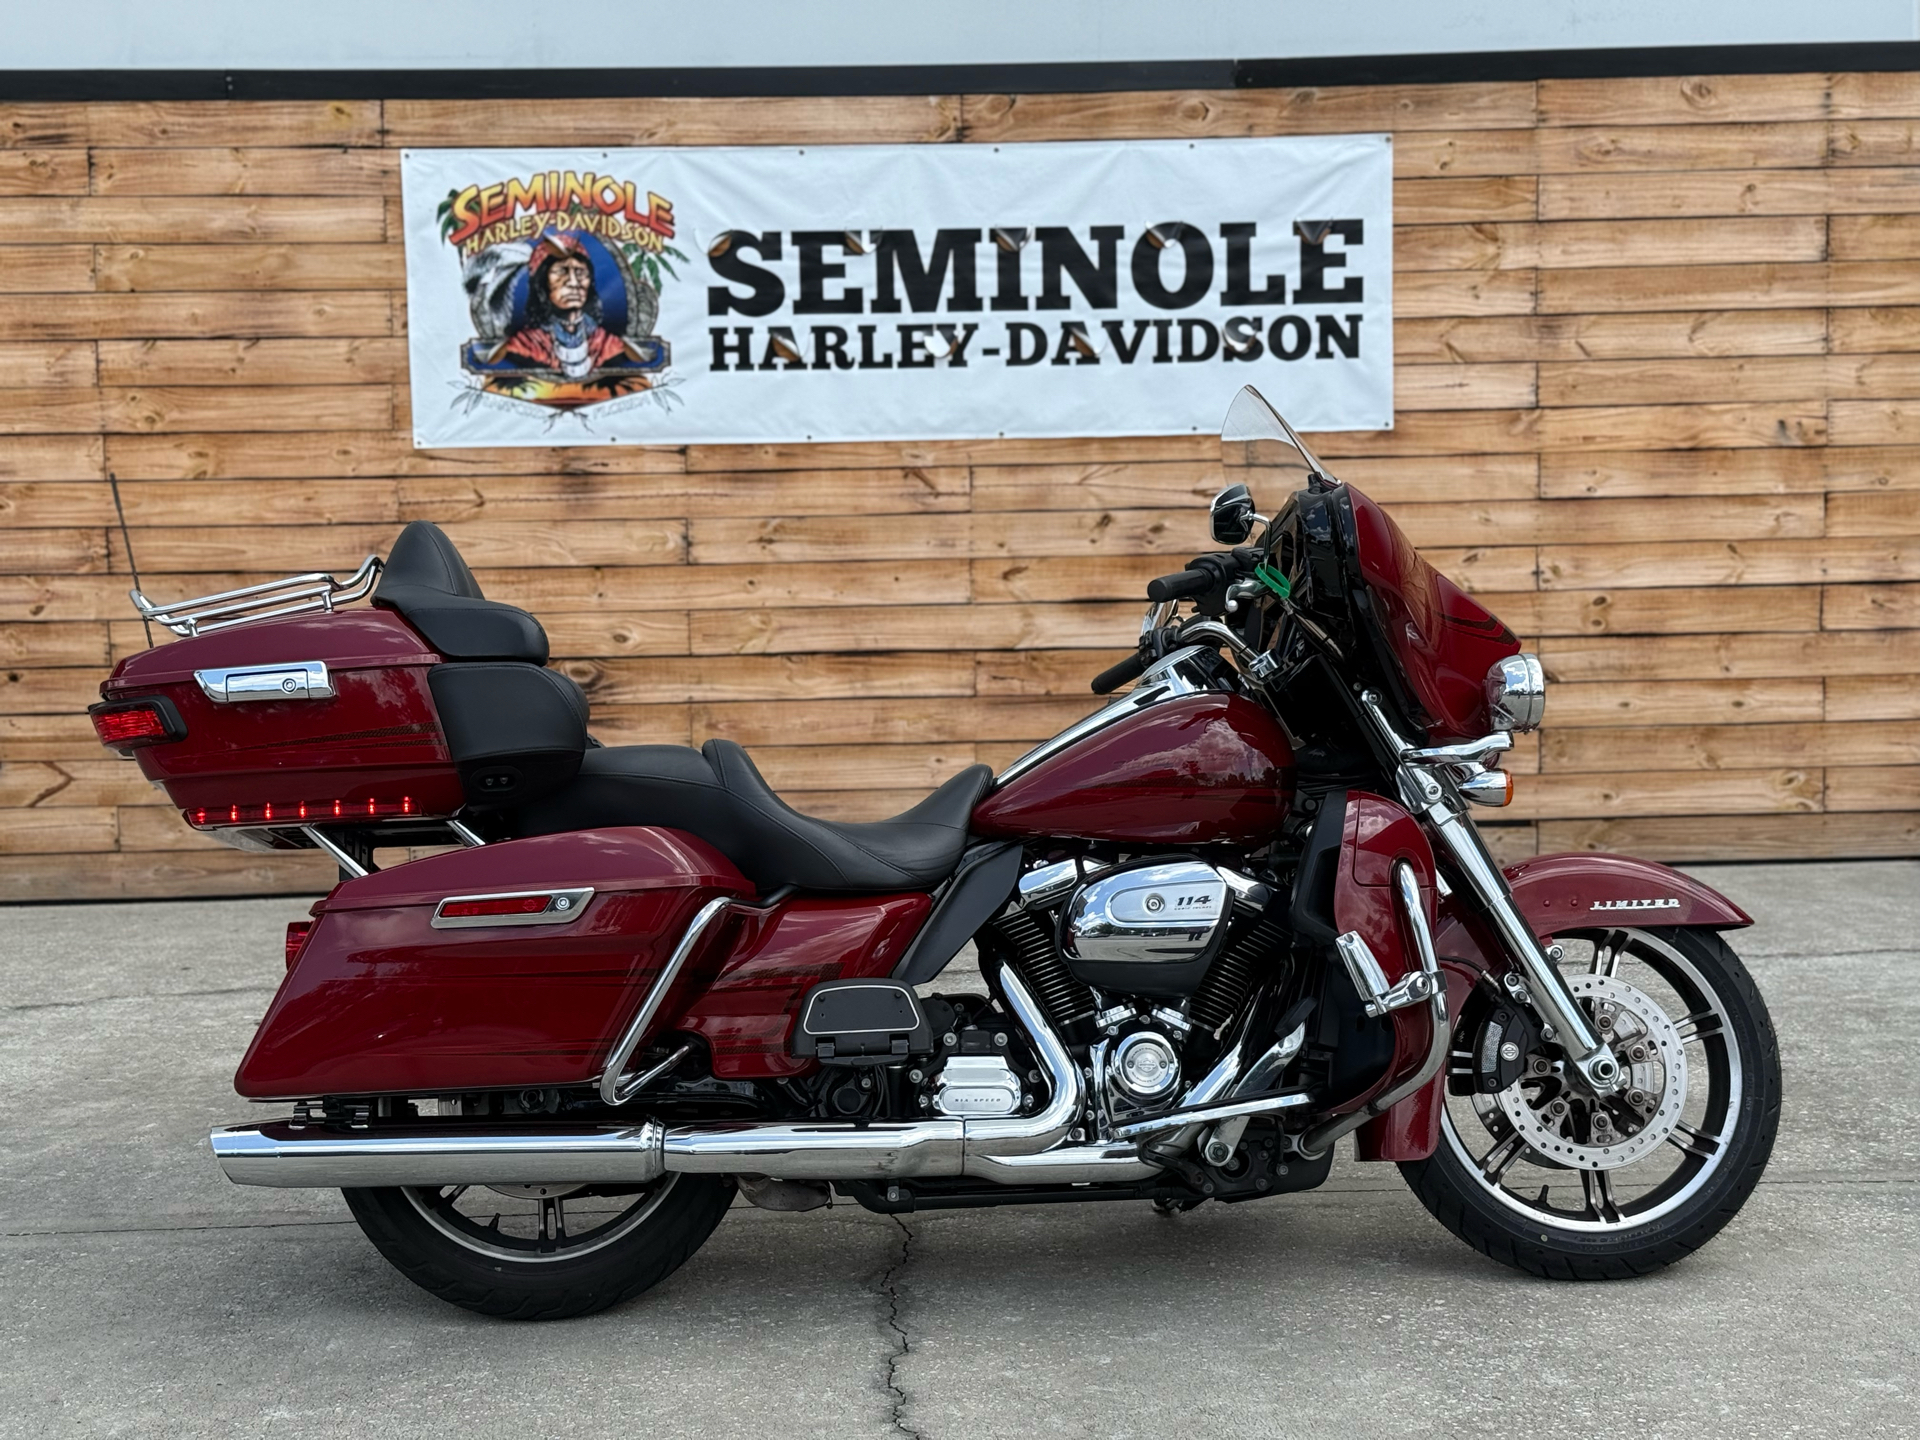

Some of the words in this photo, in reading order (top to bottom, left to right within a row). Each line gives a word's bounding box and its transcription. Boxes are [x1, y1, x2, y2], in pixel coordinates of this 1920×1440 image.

[449, 171, 675, 244] SEMINOLE
[465, 211, 664, 255] HARLEY-DAVIDSON
[706, 219, 1364, 316] SEMINOLE
[709, 315, 1364, 370] HARLEY-DAVIDSON
[1177, 895, 1212, 906] 114
[1590, 898, 1680, 910] LIMITED
